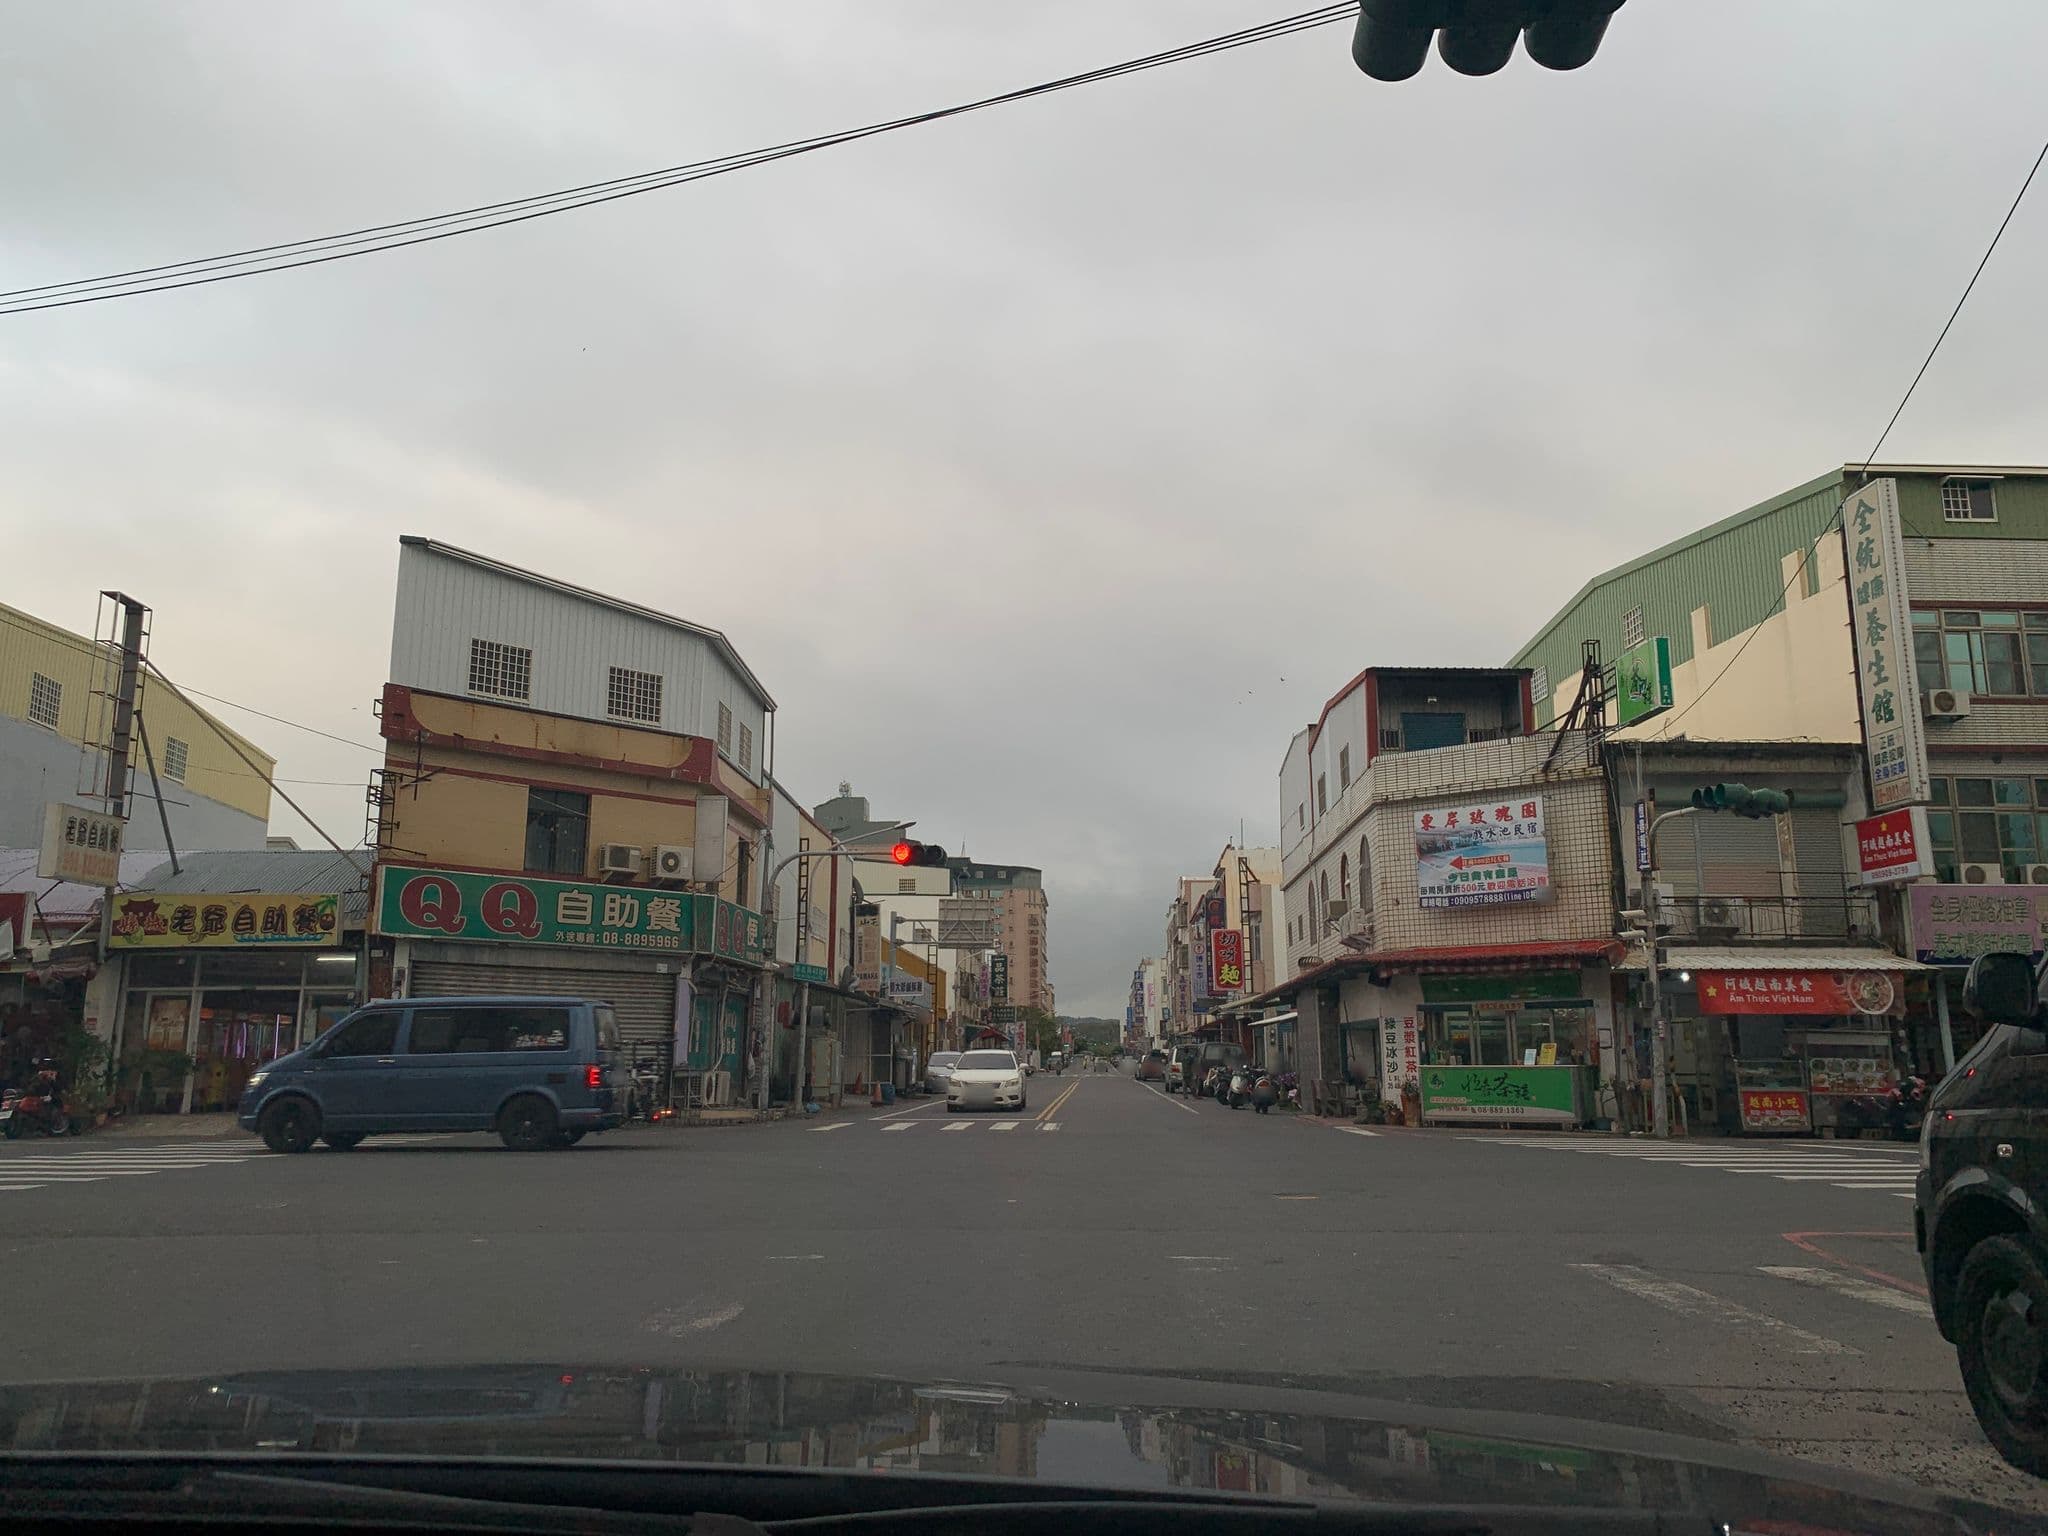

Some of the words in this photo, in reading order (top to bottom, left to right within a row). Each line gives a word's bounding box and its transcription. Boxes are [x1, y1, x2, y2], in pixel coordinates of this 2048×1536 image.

[170, 903, 319, 934] 老爺自助餐
[1384, 1017, 1399, 1074] 綠豆冰沙
